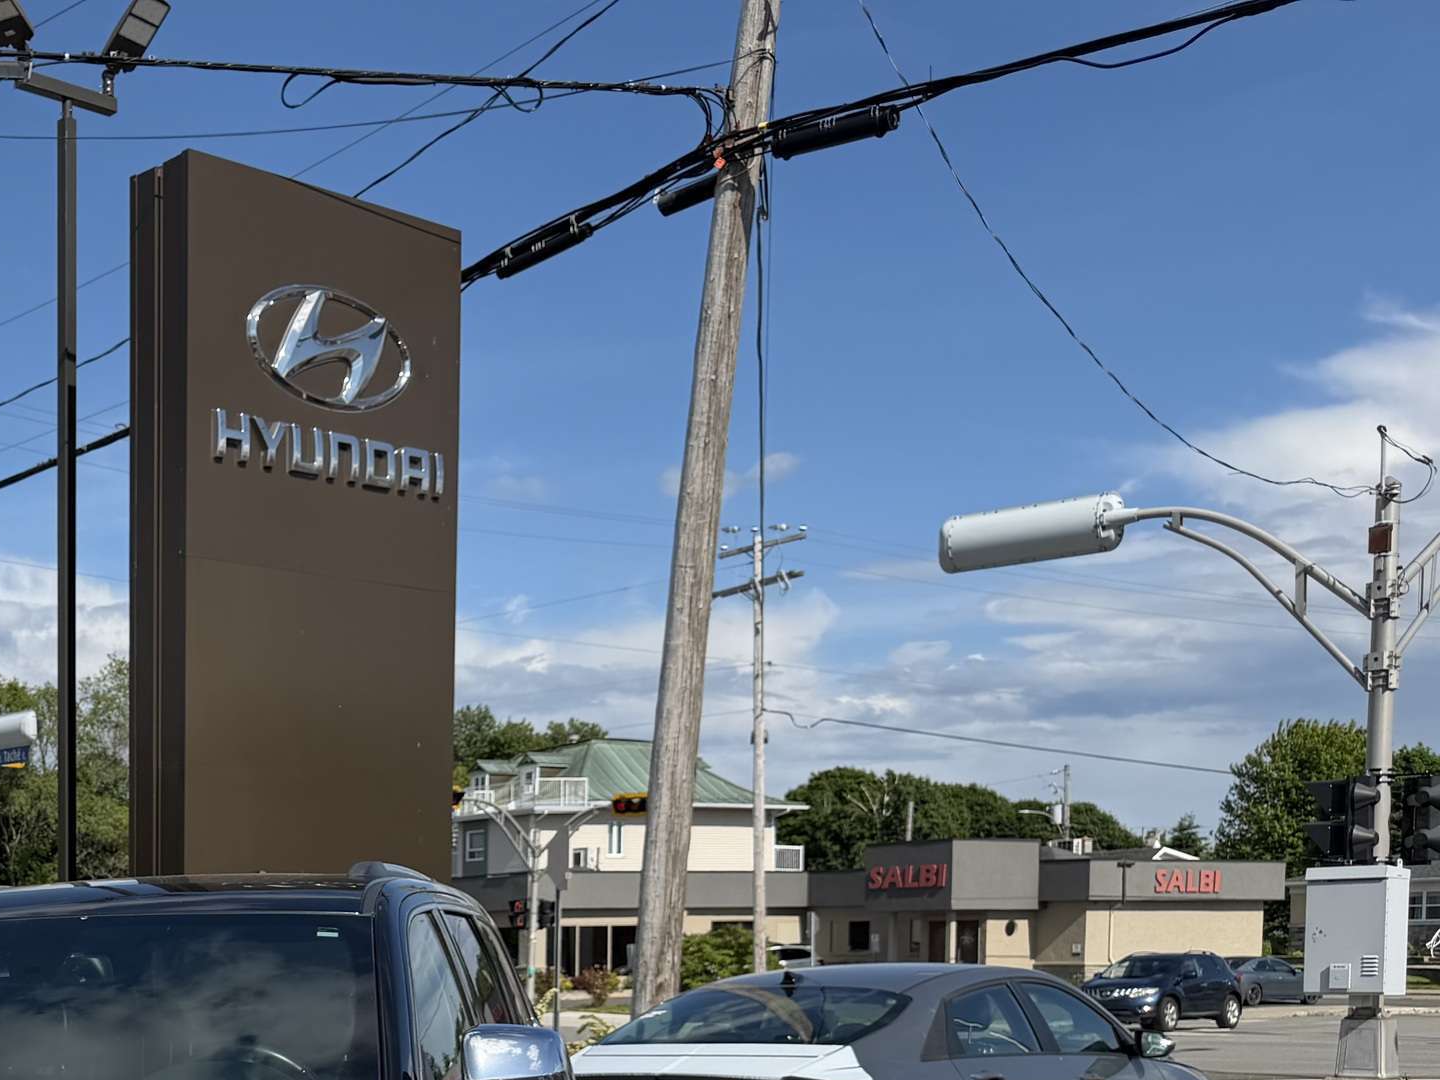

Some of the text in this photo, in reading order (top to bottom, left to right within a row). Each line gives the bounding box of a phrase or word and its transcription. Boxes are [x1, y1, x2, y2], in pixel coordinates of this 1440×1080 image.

[212, 408, 445, 500] HYUNDAI
[868, 864, 948, 889] SALBI
[1153, 867, 1222, 894] SALBI
